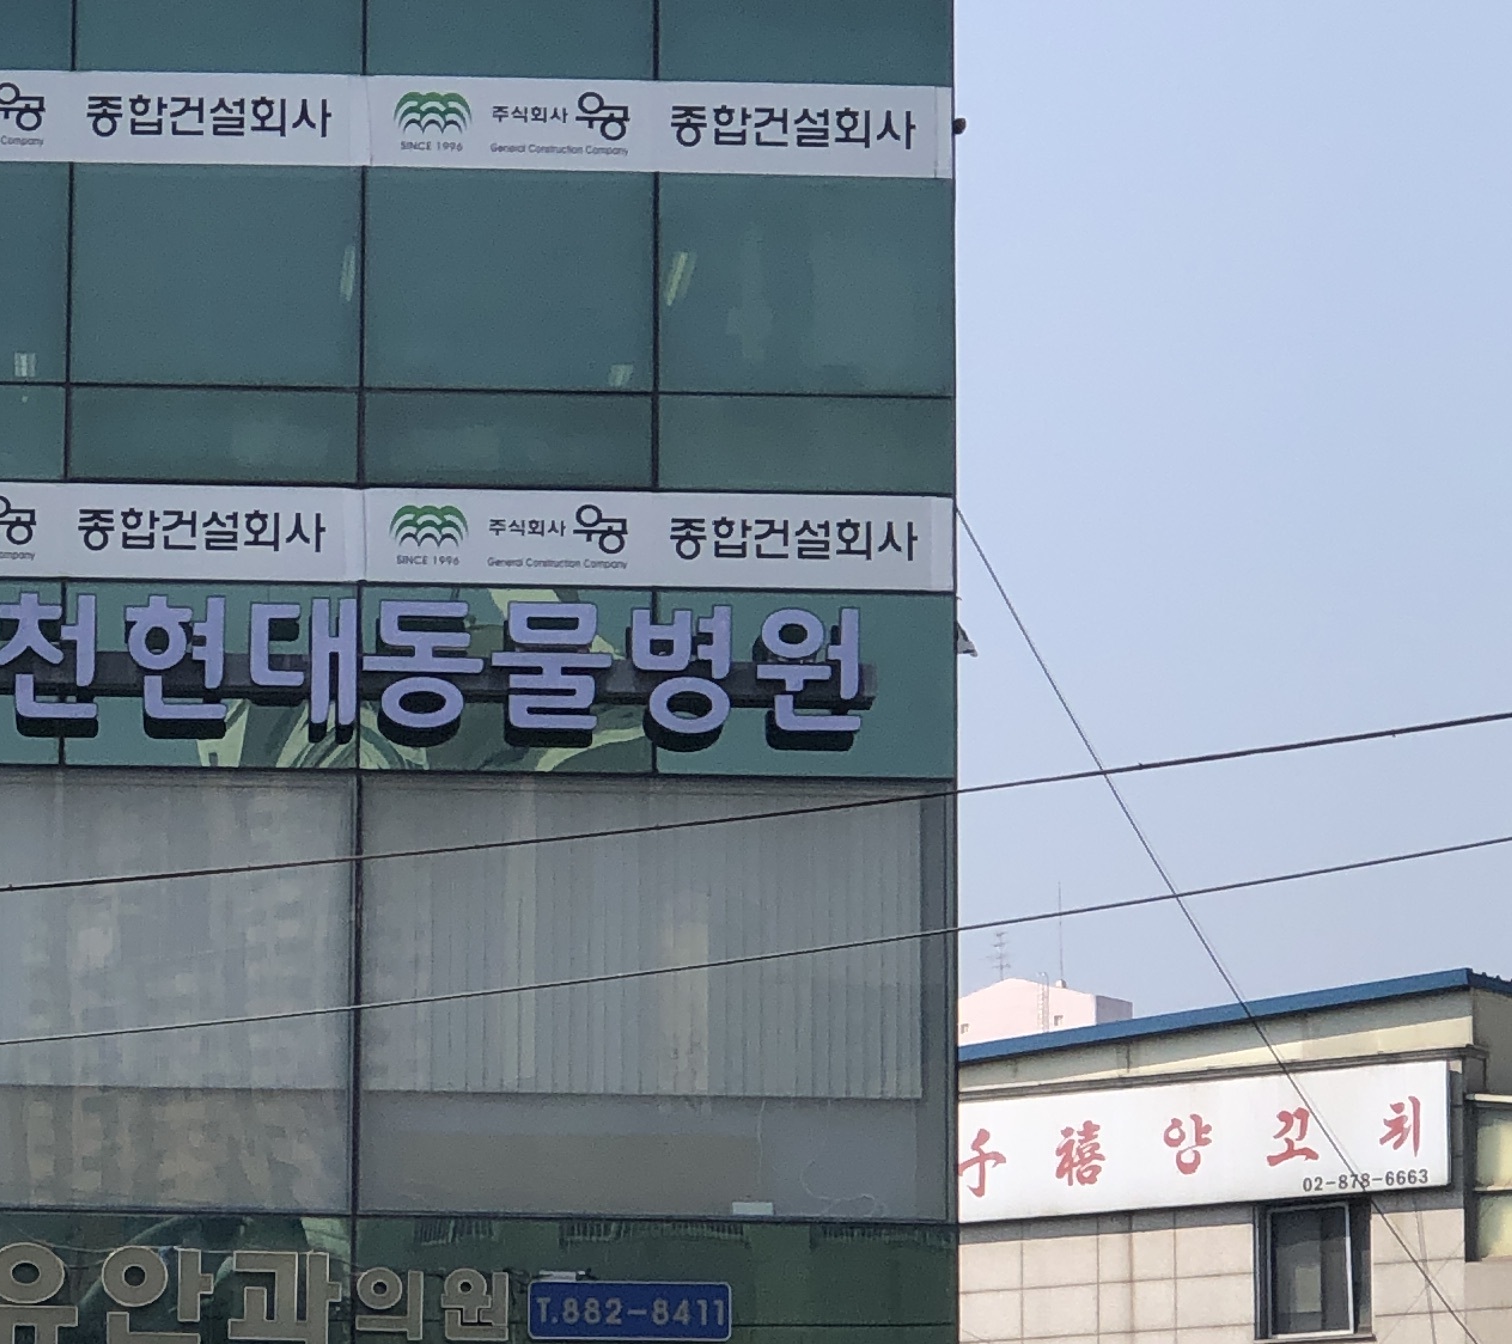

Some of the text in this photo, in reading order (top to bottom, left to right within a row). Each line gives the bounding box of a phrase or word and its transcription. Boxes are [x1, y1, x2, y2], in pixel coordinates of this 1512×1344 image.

[86, 93, 332, 139] 종합건설회사
[491, 103, 569, 125] 주식회사
[671, 104, 917, 150] 종합건설회사
[400, 141, 432, 152] SINCE
[77, 506, 326, 554] 종합건설회사
[489, 516, 566, 538] 주식회사
[669, 516, 919, 562] 종합건설회사
[396, 554, 428, 566] SINCE
[1302, 1168, 1430, 1193] 02-878-6663
